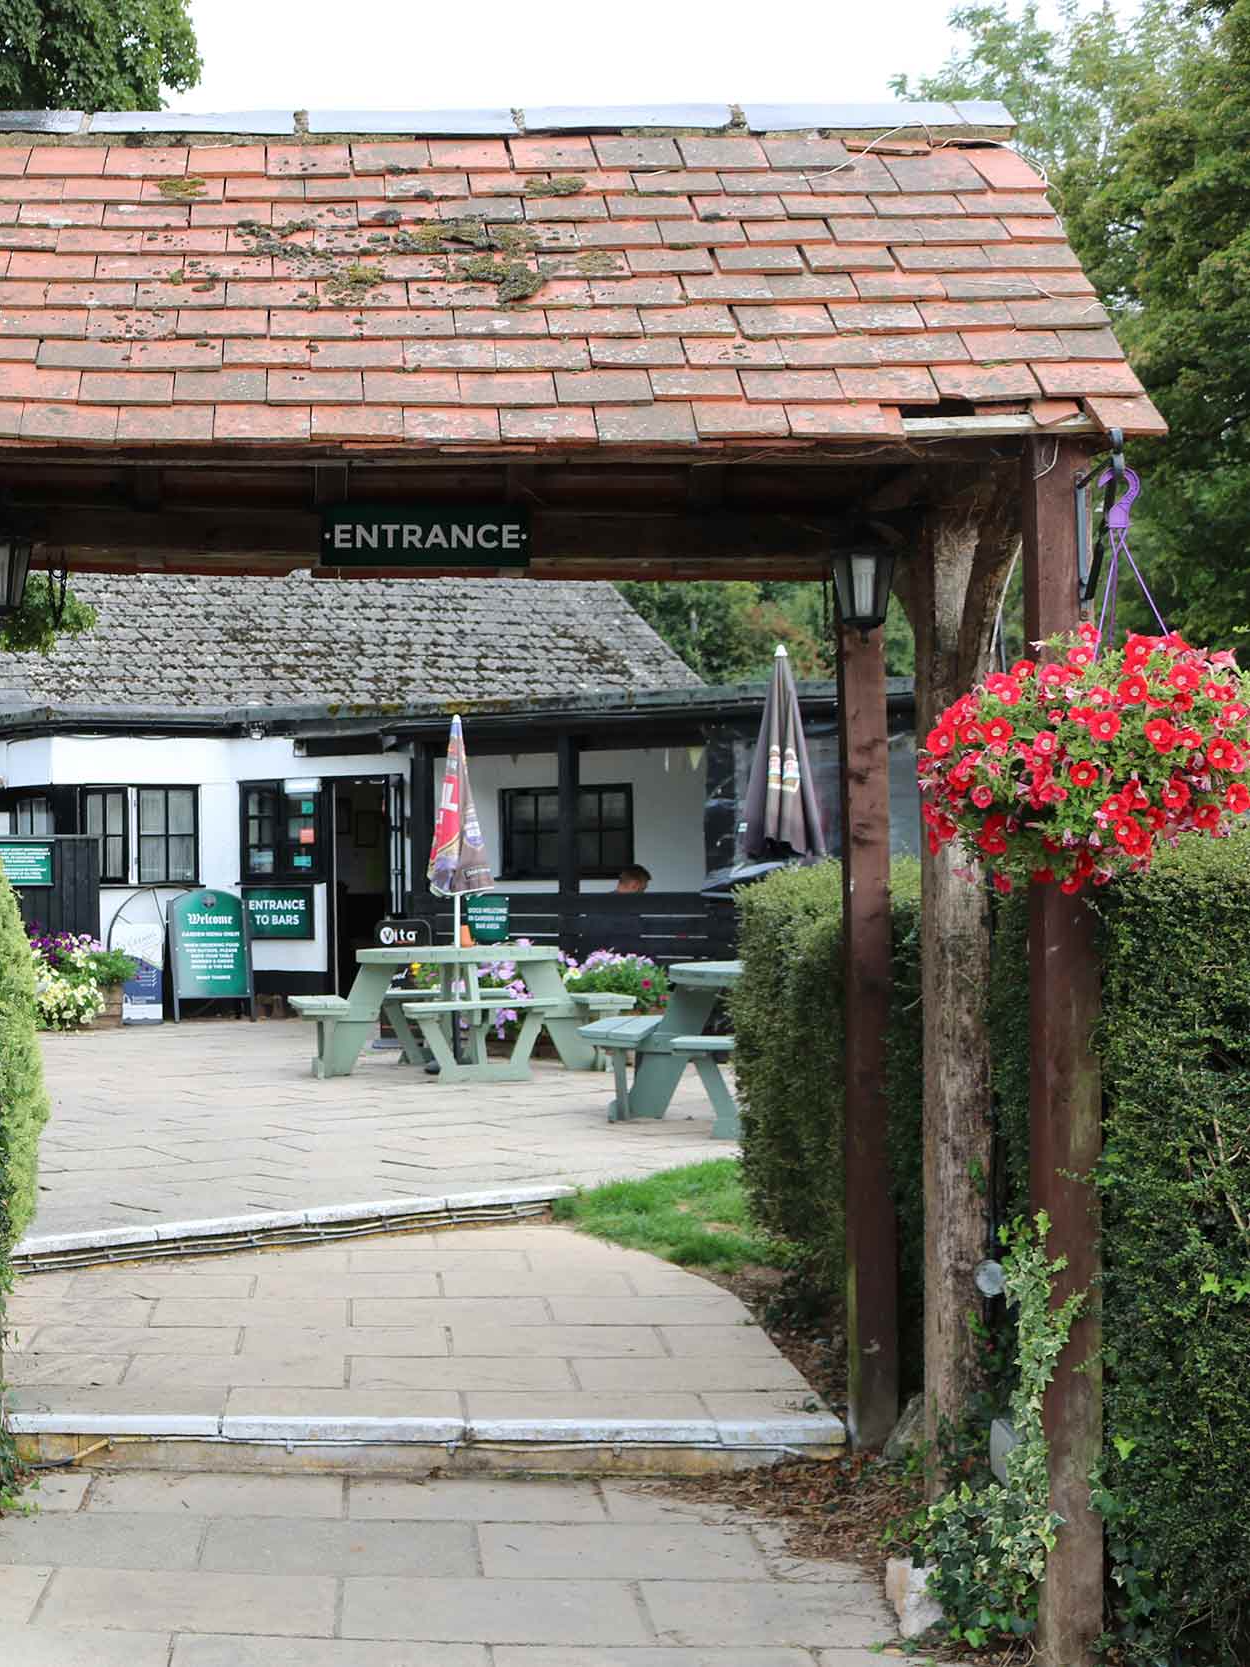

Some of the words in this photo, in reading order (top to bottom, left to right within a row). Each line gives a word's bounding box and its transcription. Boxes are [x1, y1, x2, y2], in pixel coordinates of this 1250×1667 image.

[333, 523, 521, 549] ENTRANCE
[248, 899, 306, 910] ENTRANCE
[186, 912, 234, 925] Welcome
[254, 914, 270, 925] TO
[271, 914, 300, 925] BARS
